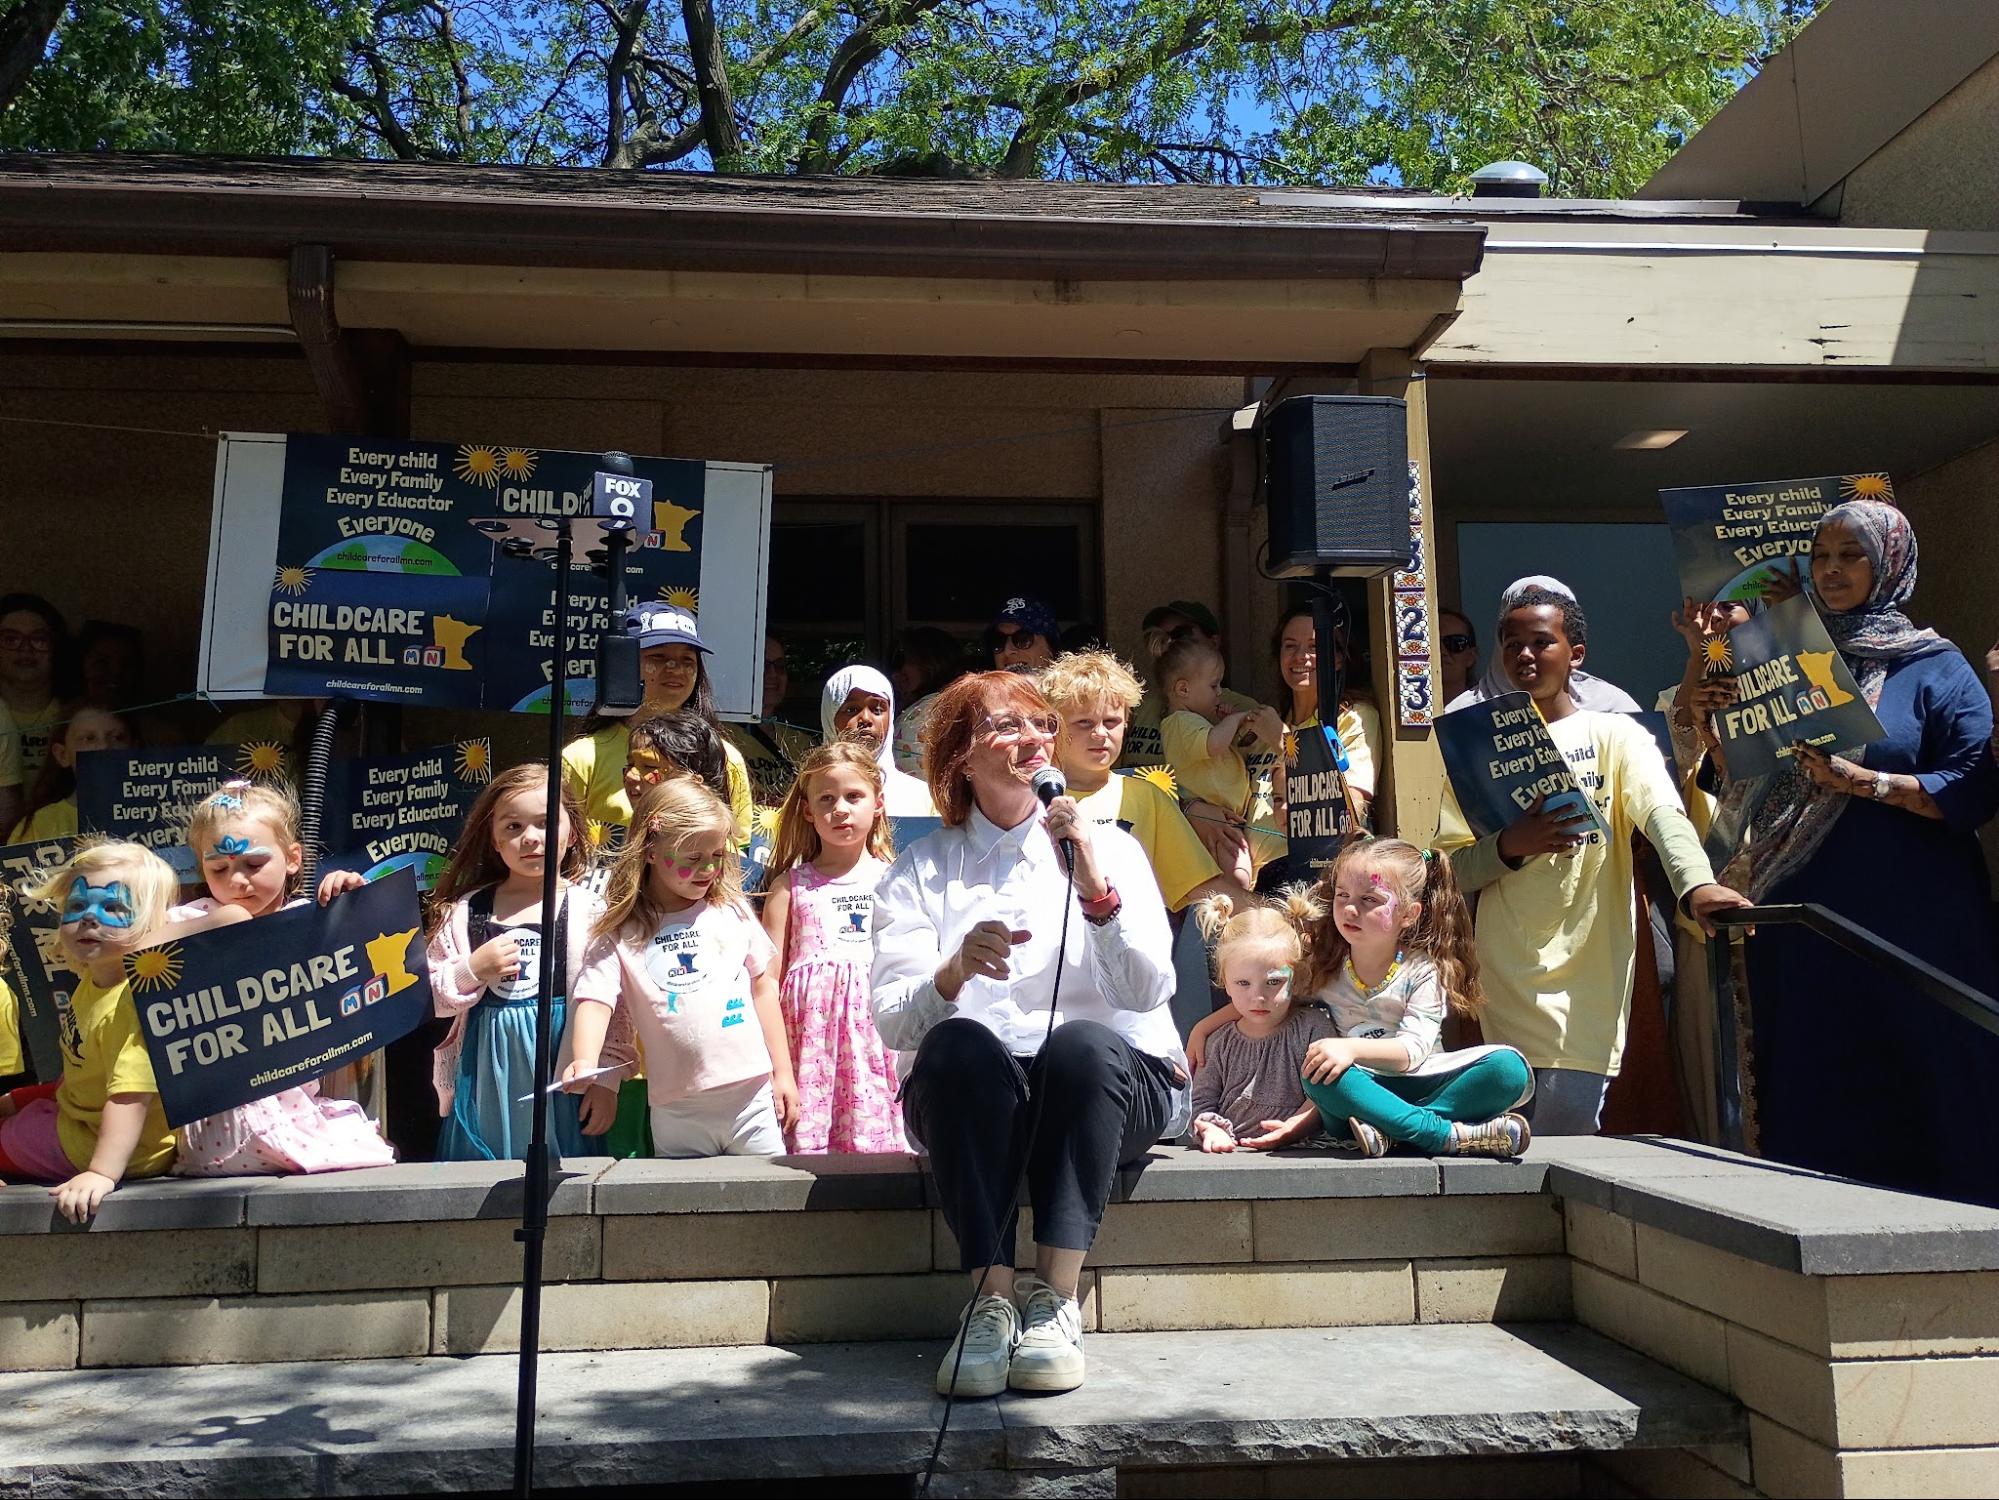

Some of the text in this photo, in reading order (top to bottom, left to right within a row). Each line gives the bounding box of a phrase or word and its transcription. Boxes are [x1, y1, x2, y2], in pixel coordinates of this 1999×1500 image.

[349, 447, 438, 470] Every child
[340, 468, 444, 493] Every Family
[605, 477, 642, 498] FOX
[326, 488, 453, 512] Every Educator
[503, 487, 583, 516] CHILD
[1725, 486, 1822, 507] Every child
[1722, 501, 1833, 522] Every Family
[337, 515, 436, 544] Everyone
[1715, 520, 1818, 540] Every Educa
[336, 551, 433, 567] childcareforallmn.com
[1733, 537, 1812, 567] Everyo
[273, 601, 425, 635] CHILDCARE
[542, 609, 588, 631] Ery
[279, 634, 333, 662] FOR
[344, 637, 395, 665] ALL
[529, 630, 575, 651] Evey
[326, 680, 423, 694] childcareforallmn.com
[1737, 654, 1799, 702] HILDCARE
[1491, 707, 1529, 729] Every
[1725, 703, 1772, 740] FOR
[1769, 695, 1798, 726] ALL
[1145, 743, 1164, 754] AL
[1493, 729, 1535, 752] Every
[128, 756, 219, 779] Every child
[368, 758, 443, 785] Every child
[1489, 755, 1535, 779] Every
[122, 781, 168, 800] Every
[362, 780, 448, 807] Every Family
[1287, 769, 1342, 805] CHILDCARE
[1510, 772, 1578, 811] Everyo
[113, 803, 158, 822] Every
[352, 803, 458, 830] Every Educator
[1290, 809, 1312, 838] FOR
[1315, 807, 1337, 837] ALL
[366, 832, 448, 863] Everyone
[655, 930, 701, 945] CHILDCARE
[662, 940, 699, 953] FOR ALL
[520, 948, 536, 957] ALL
[146, 945, 359, 1037] CHILDCARE
[165, 1023, 249, 1075] FOR
[262, 999, 332, 1047] ALL
[250, 1031, 373, 1088] childcareforallmn.com
